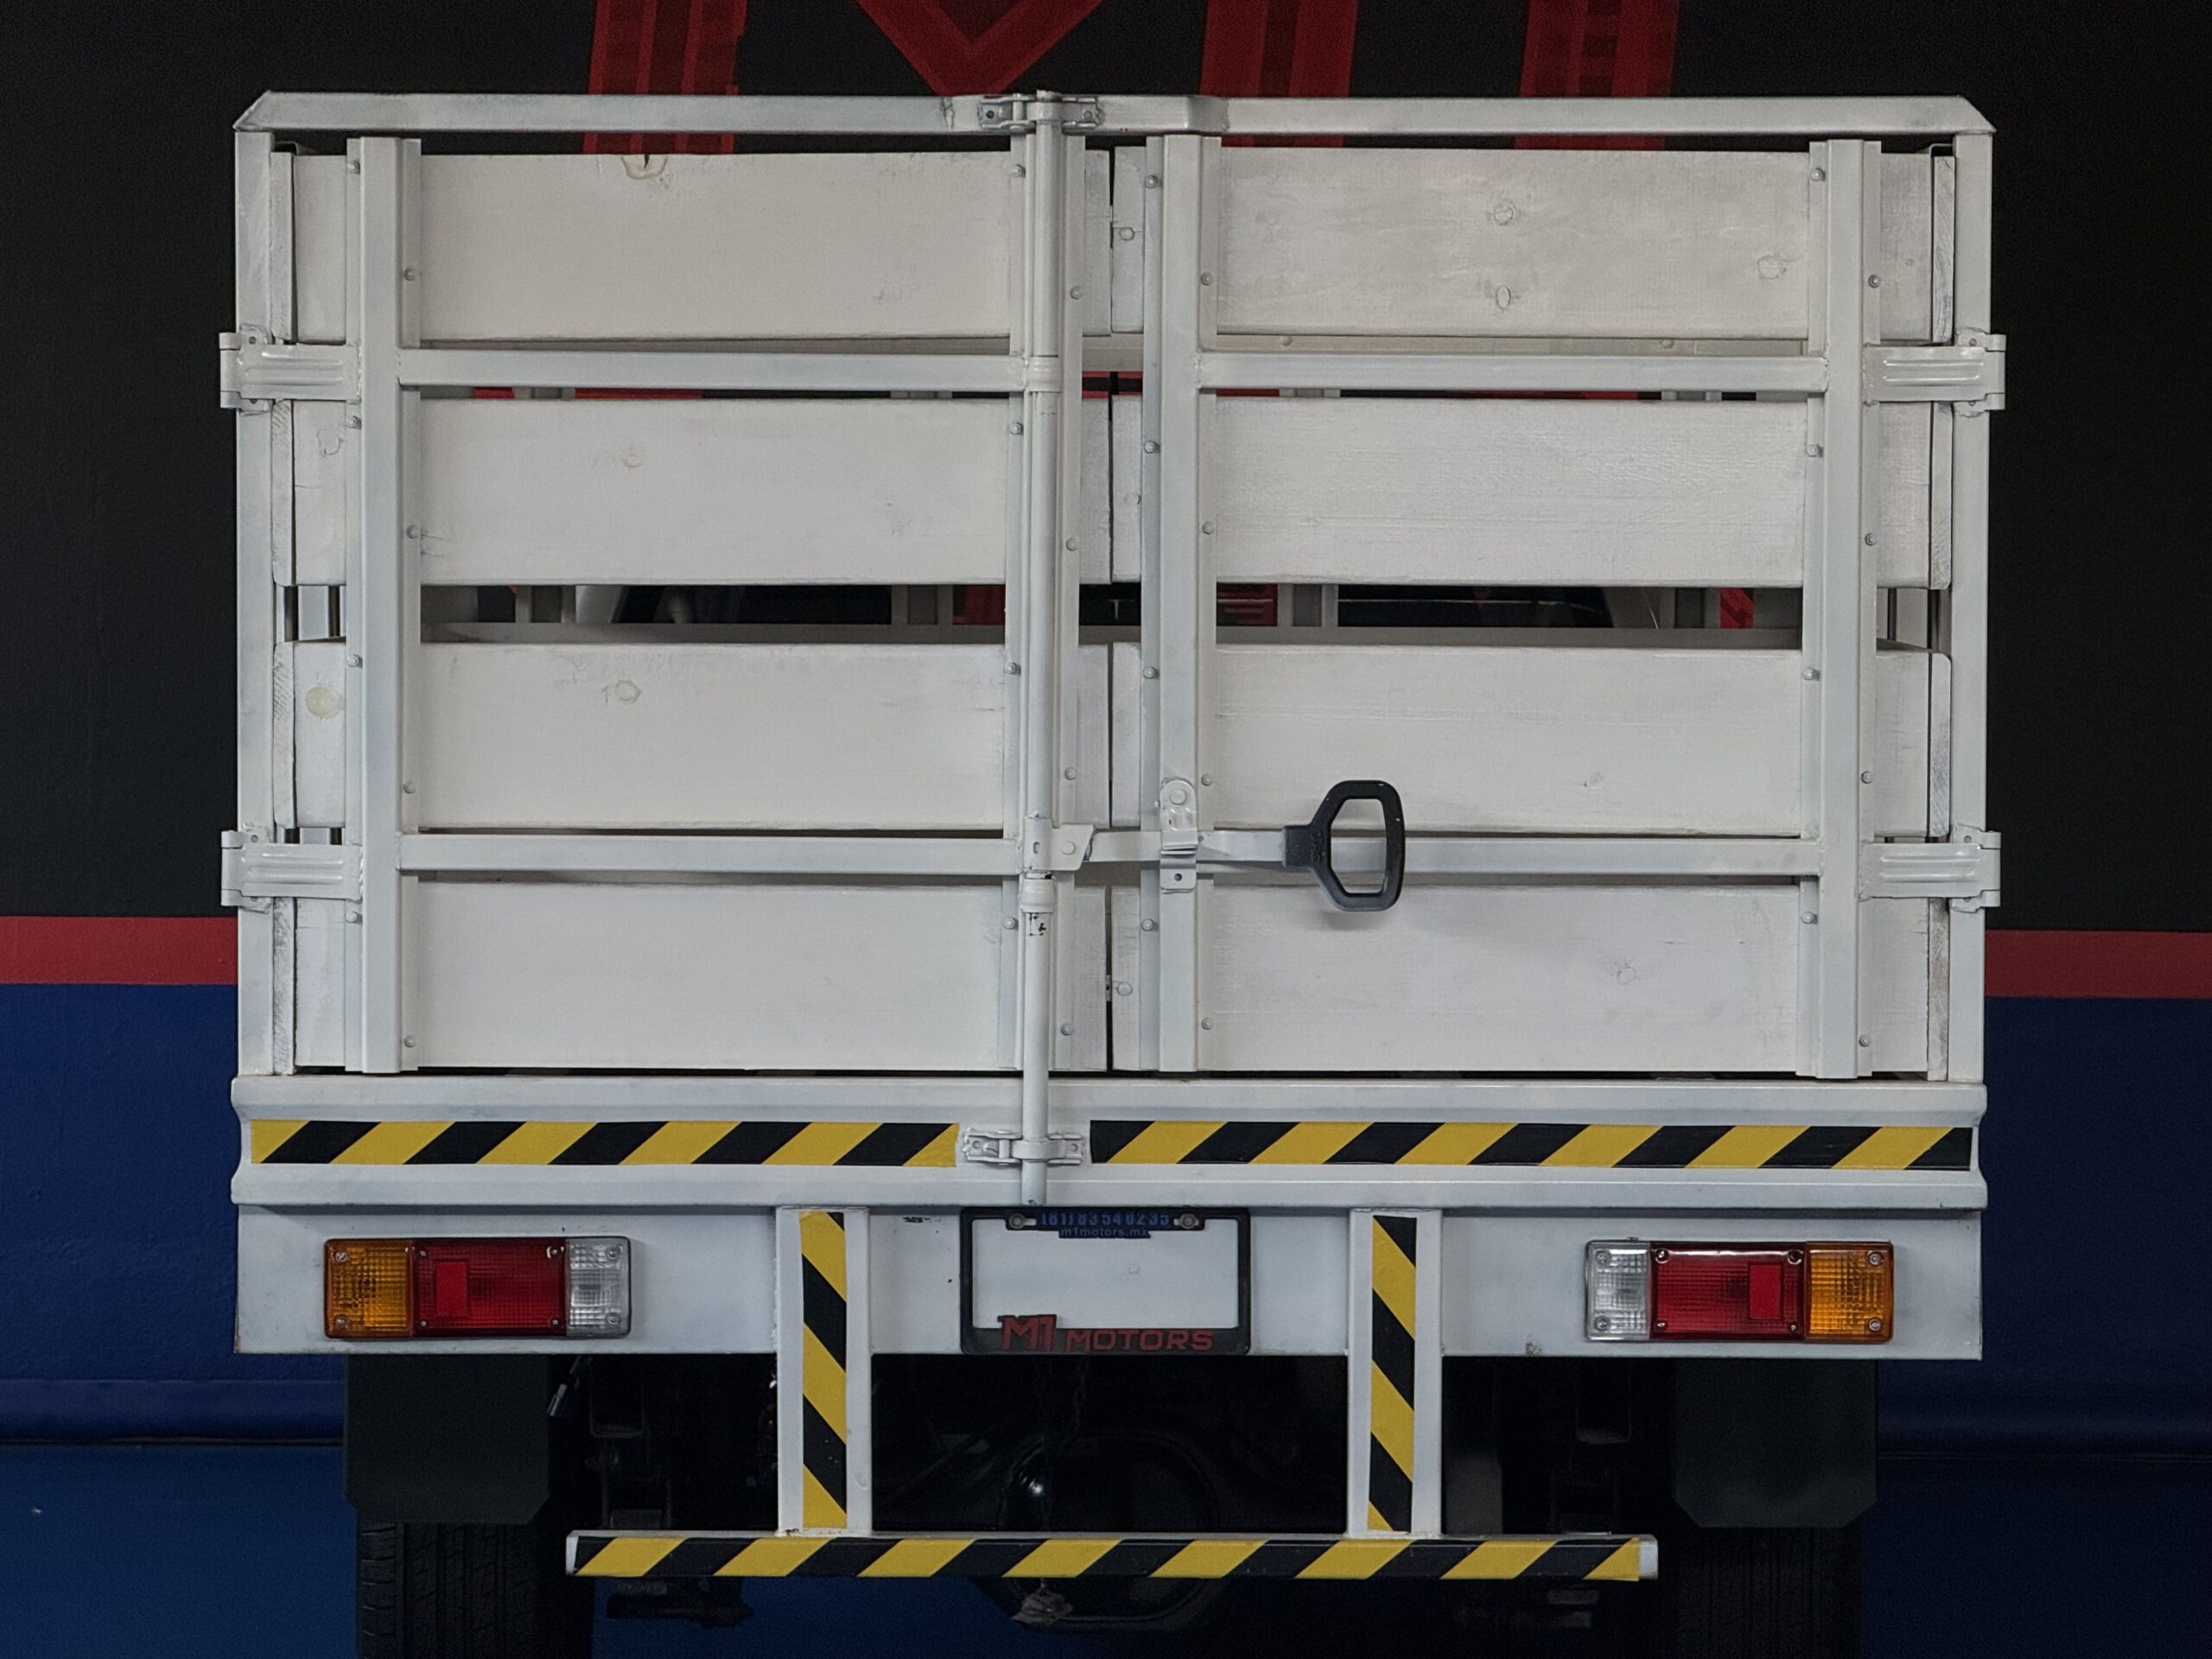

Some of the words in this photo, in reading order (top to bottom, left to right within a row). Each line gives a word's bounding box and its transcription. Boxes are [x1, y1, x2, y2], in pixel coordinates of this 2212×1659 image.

[1060, 1228, 1149, 1236] m1motors.mx
[1001, 1315, 1055, 1351] M1
[1064, 1329, 1215, 1354] MOTORS
